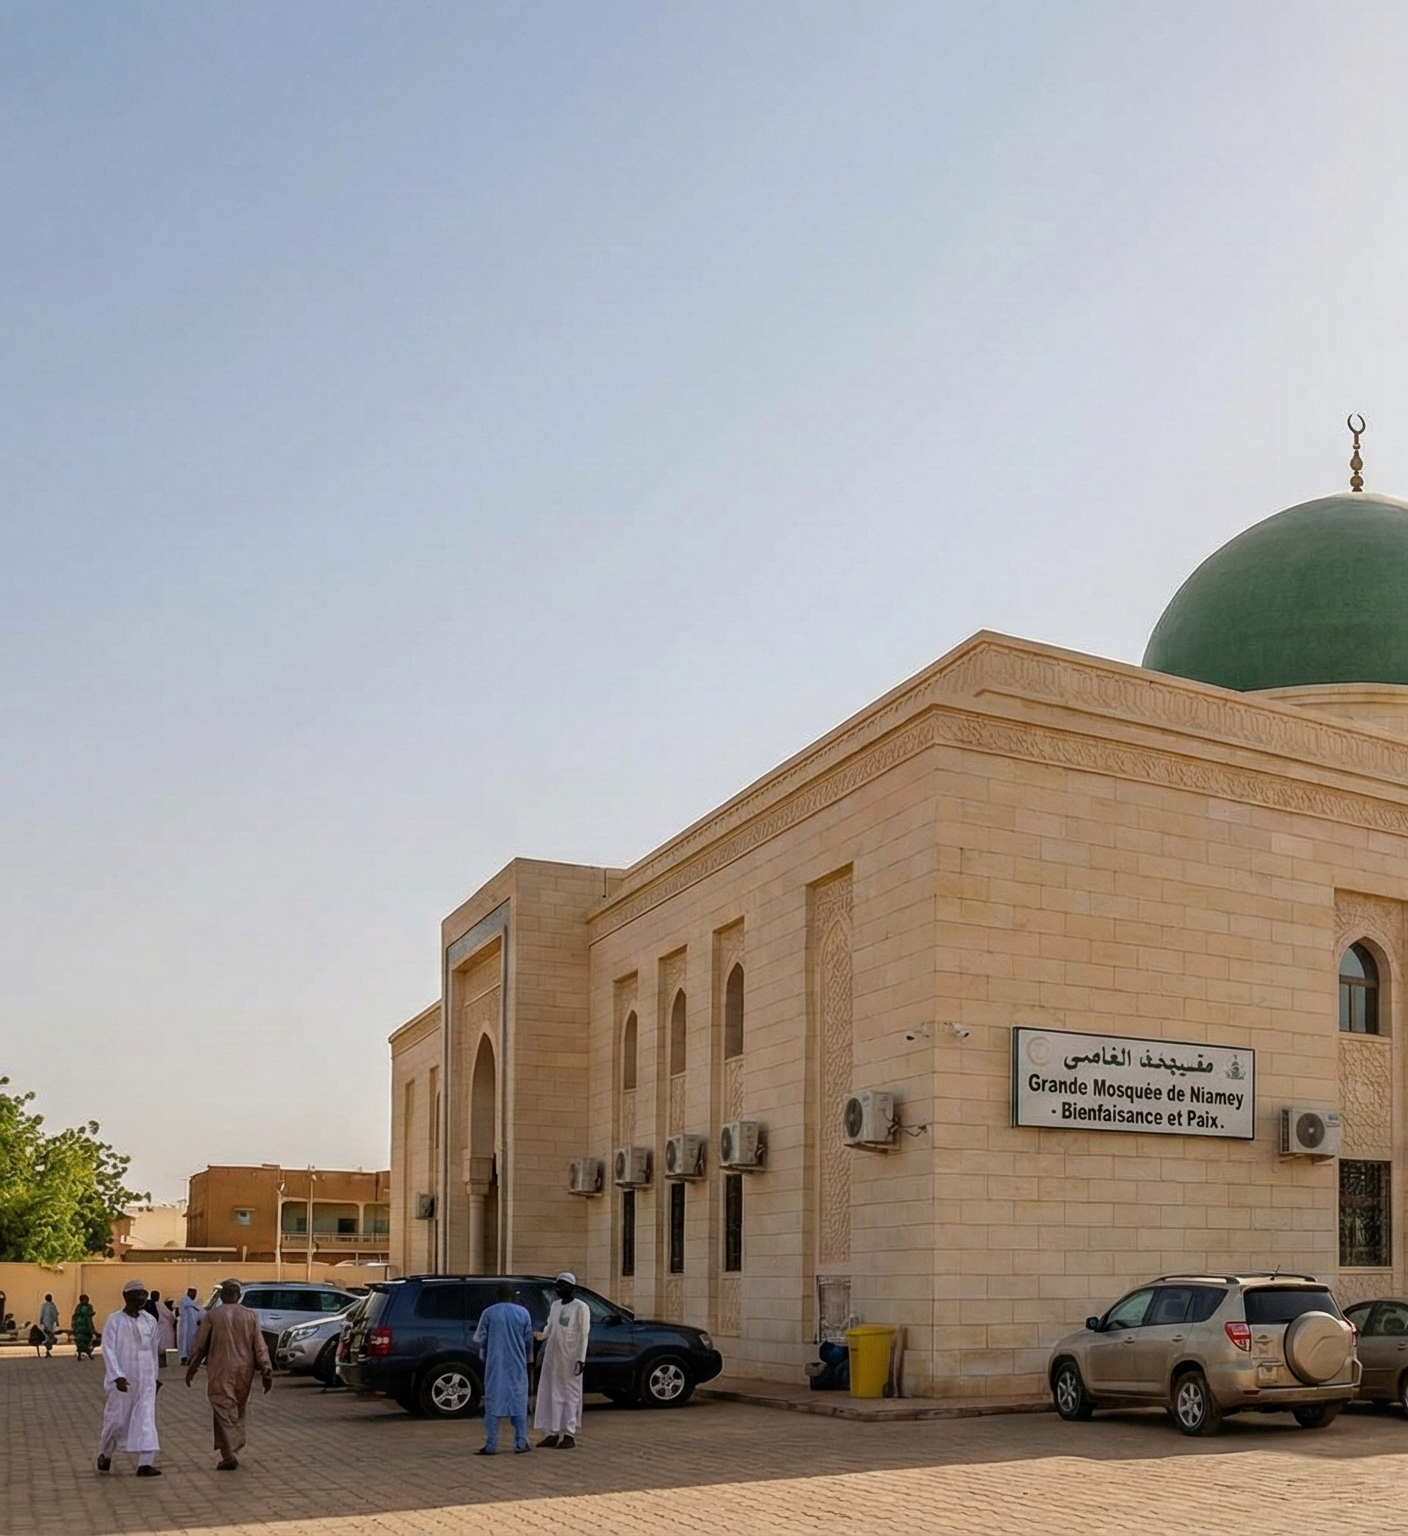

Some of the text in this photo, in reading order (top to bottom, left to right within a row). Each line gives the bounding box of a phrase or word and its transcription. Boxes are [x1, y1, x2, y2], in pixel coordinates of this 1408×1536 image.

[1028, 1073, 1244, 1111] Grande Mosquée de Niamey
[1061, 1101, 1163, 1125] Bienfaisance
[1167, 1109, 1183, 1127] et
